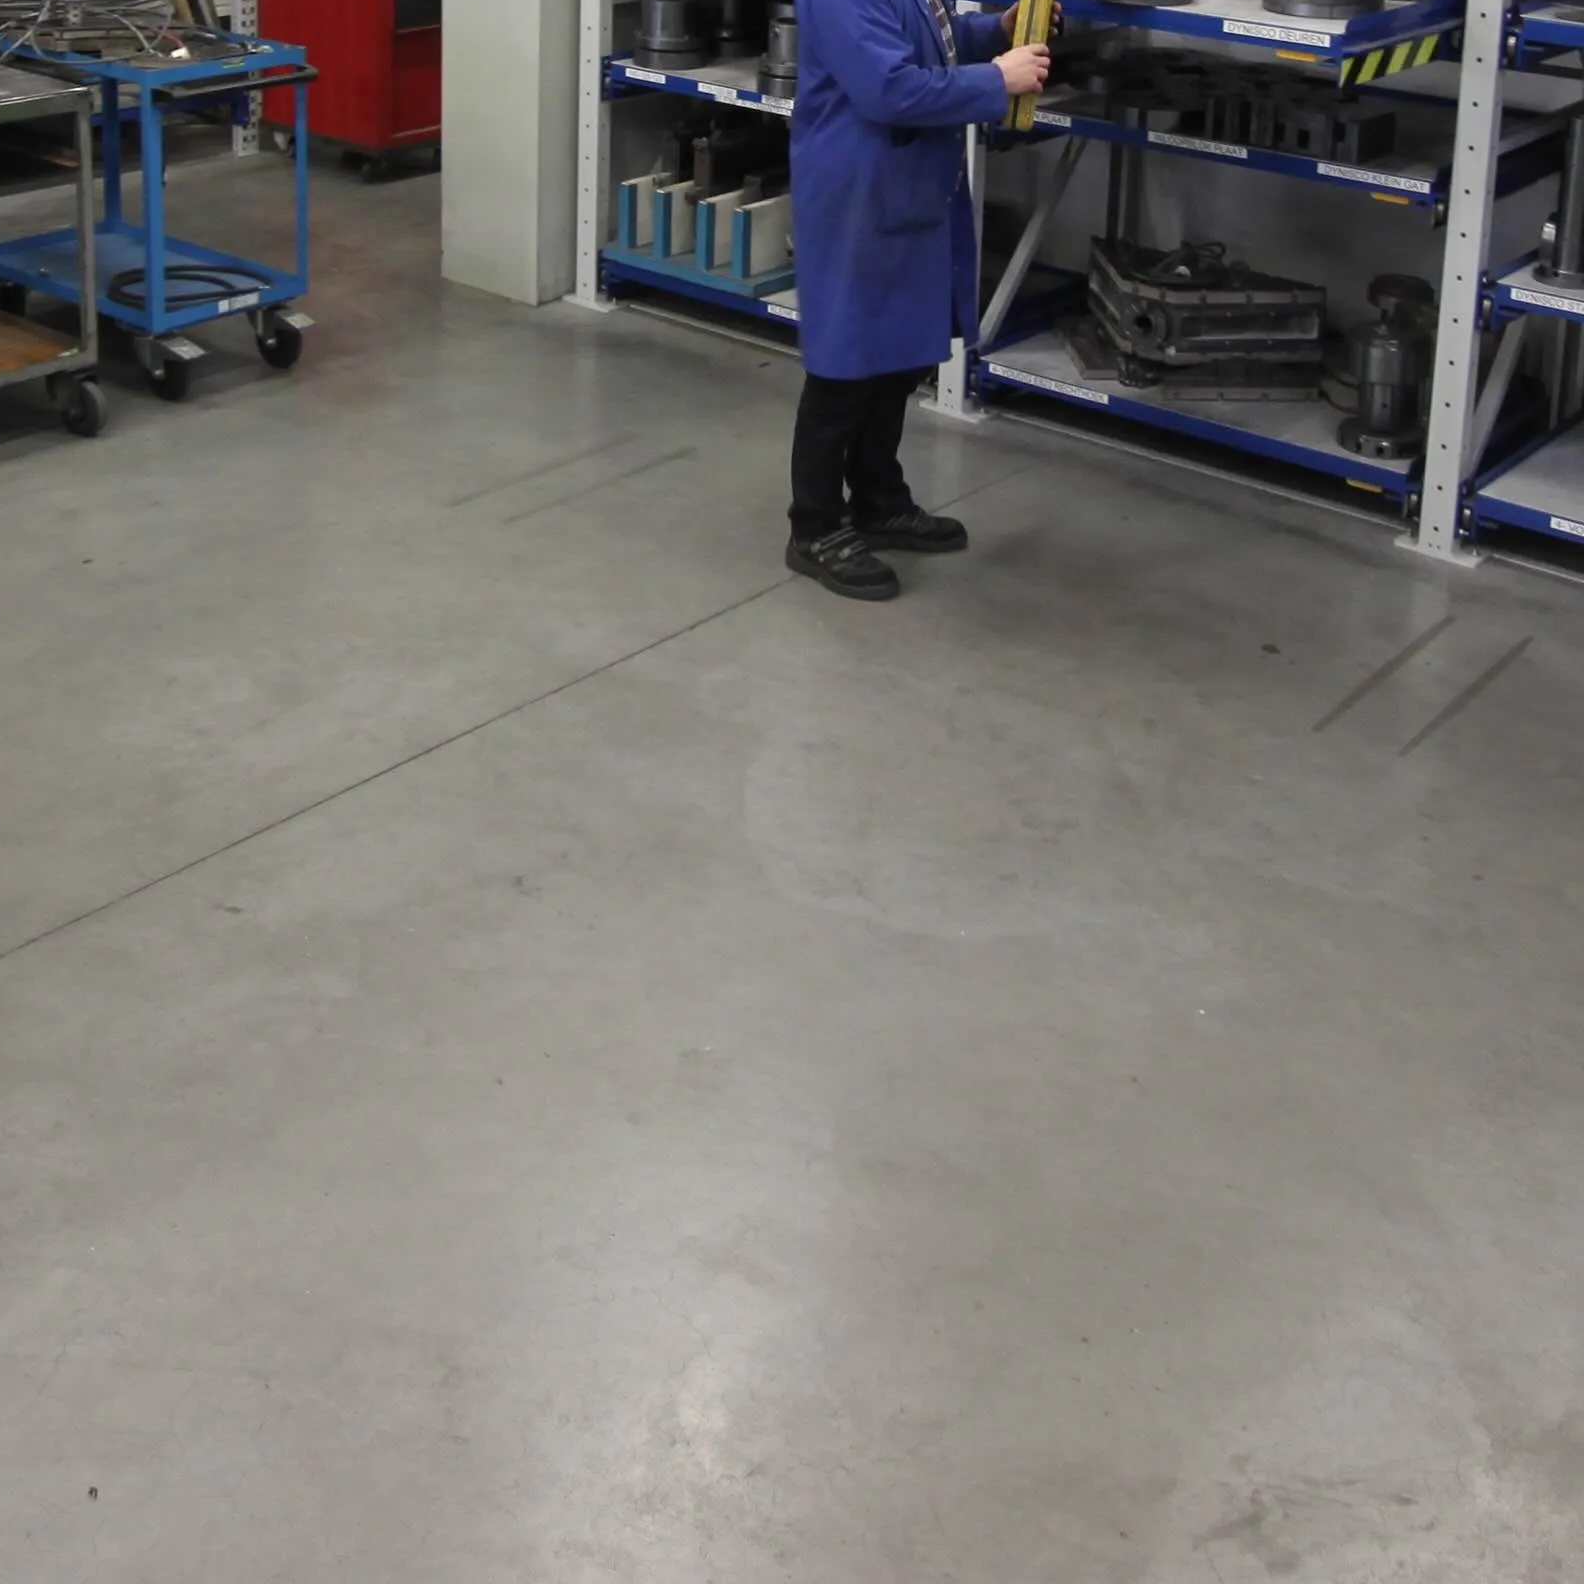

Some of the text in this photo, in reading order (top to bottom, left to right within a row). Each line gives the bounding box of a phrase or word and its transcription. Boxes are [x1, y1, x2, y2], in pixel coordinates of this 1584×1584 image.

[1227, 22, 1326, 45] DYNISCO DEUREN
[1324, 165, 1425, 192] DYNISCO KLEIN GAT
[1515, 289, 1565, 309] DYNISCO
